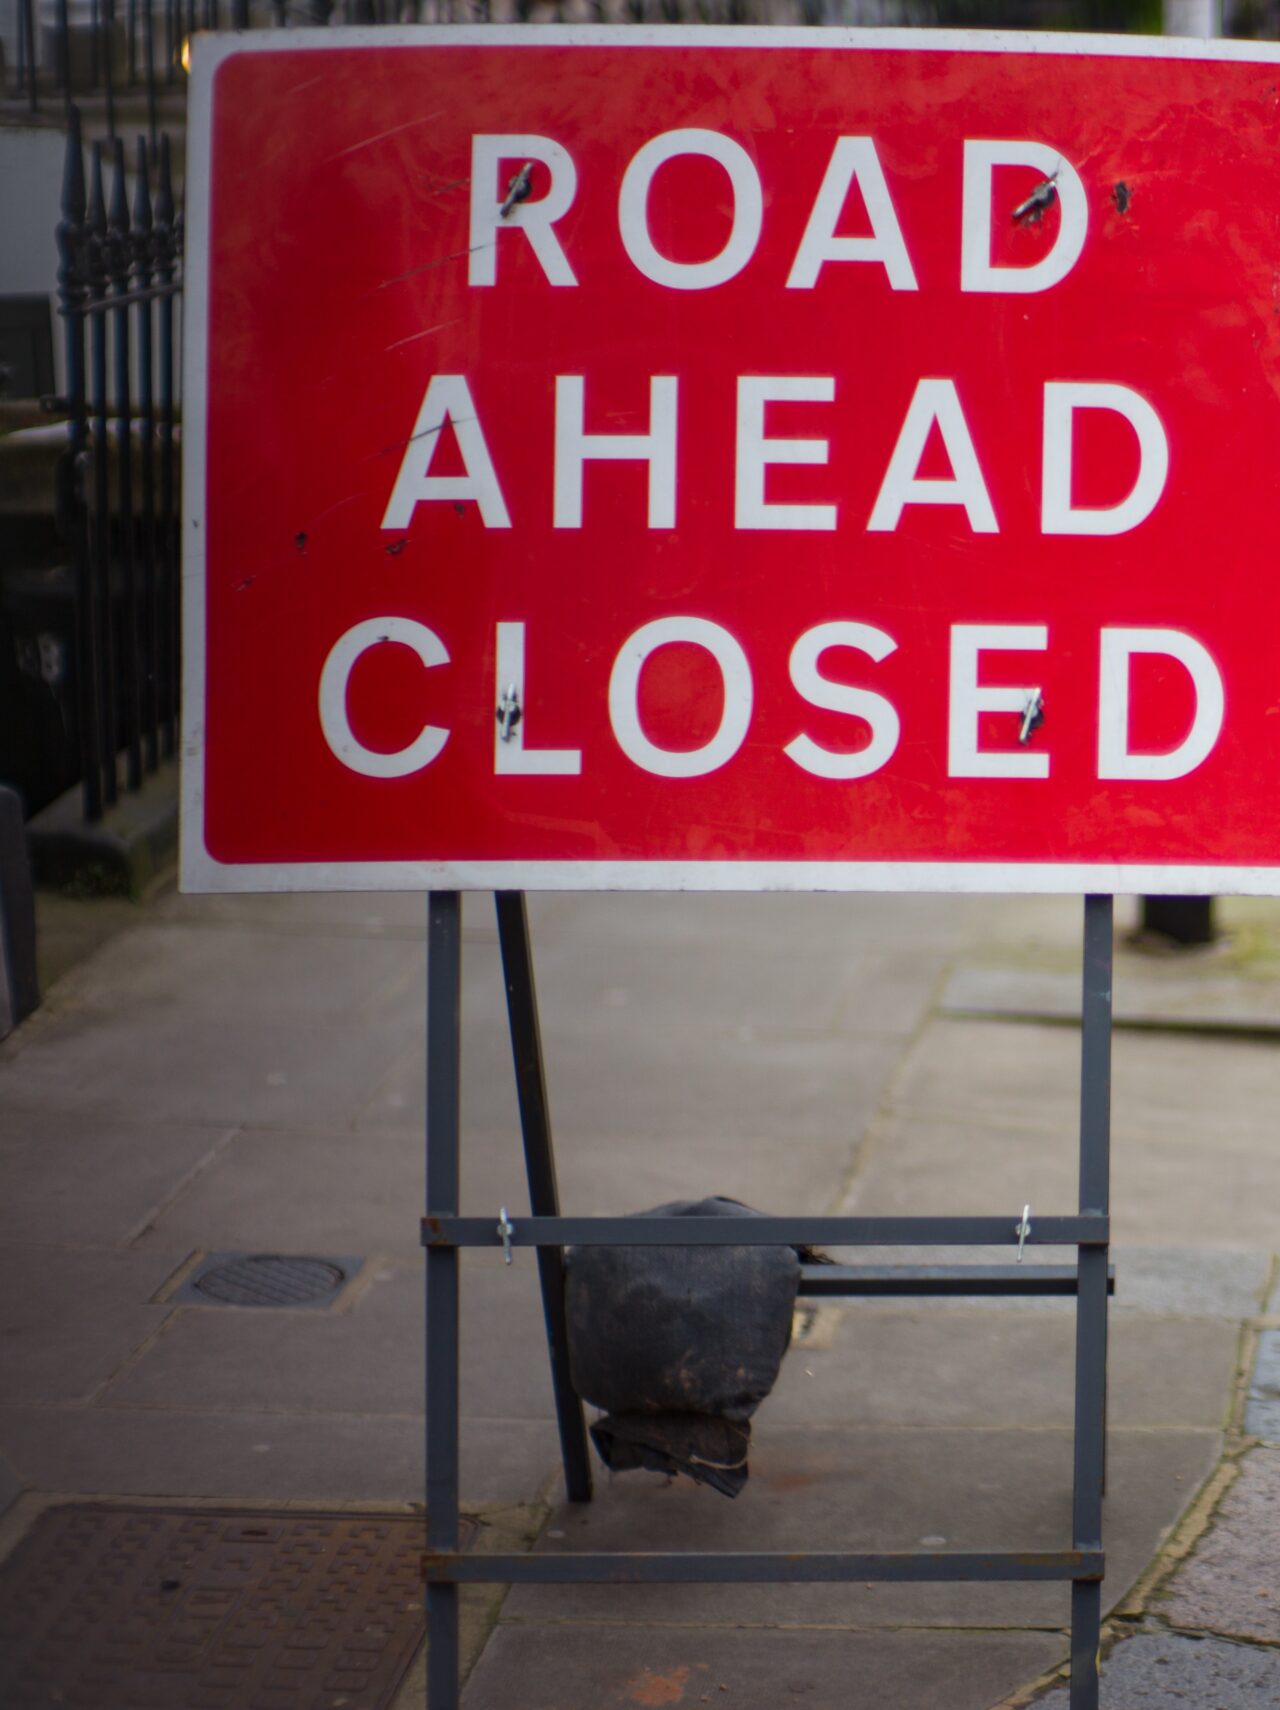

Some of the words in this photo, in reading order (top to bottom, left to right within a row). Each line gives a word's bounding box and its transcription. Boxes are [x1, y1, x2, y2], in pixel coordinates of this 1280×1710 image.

[469, 128, 1090, 292] ROAD
[383, 375, 1168, 535] AHEAD
[319, 616, 1225, 780] CLOSED
